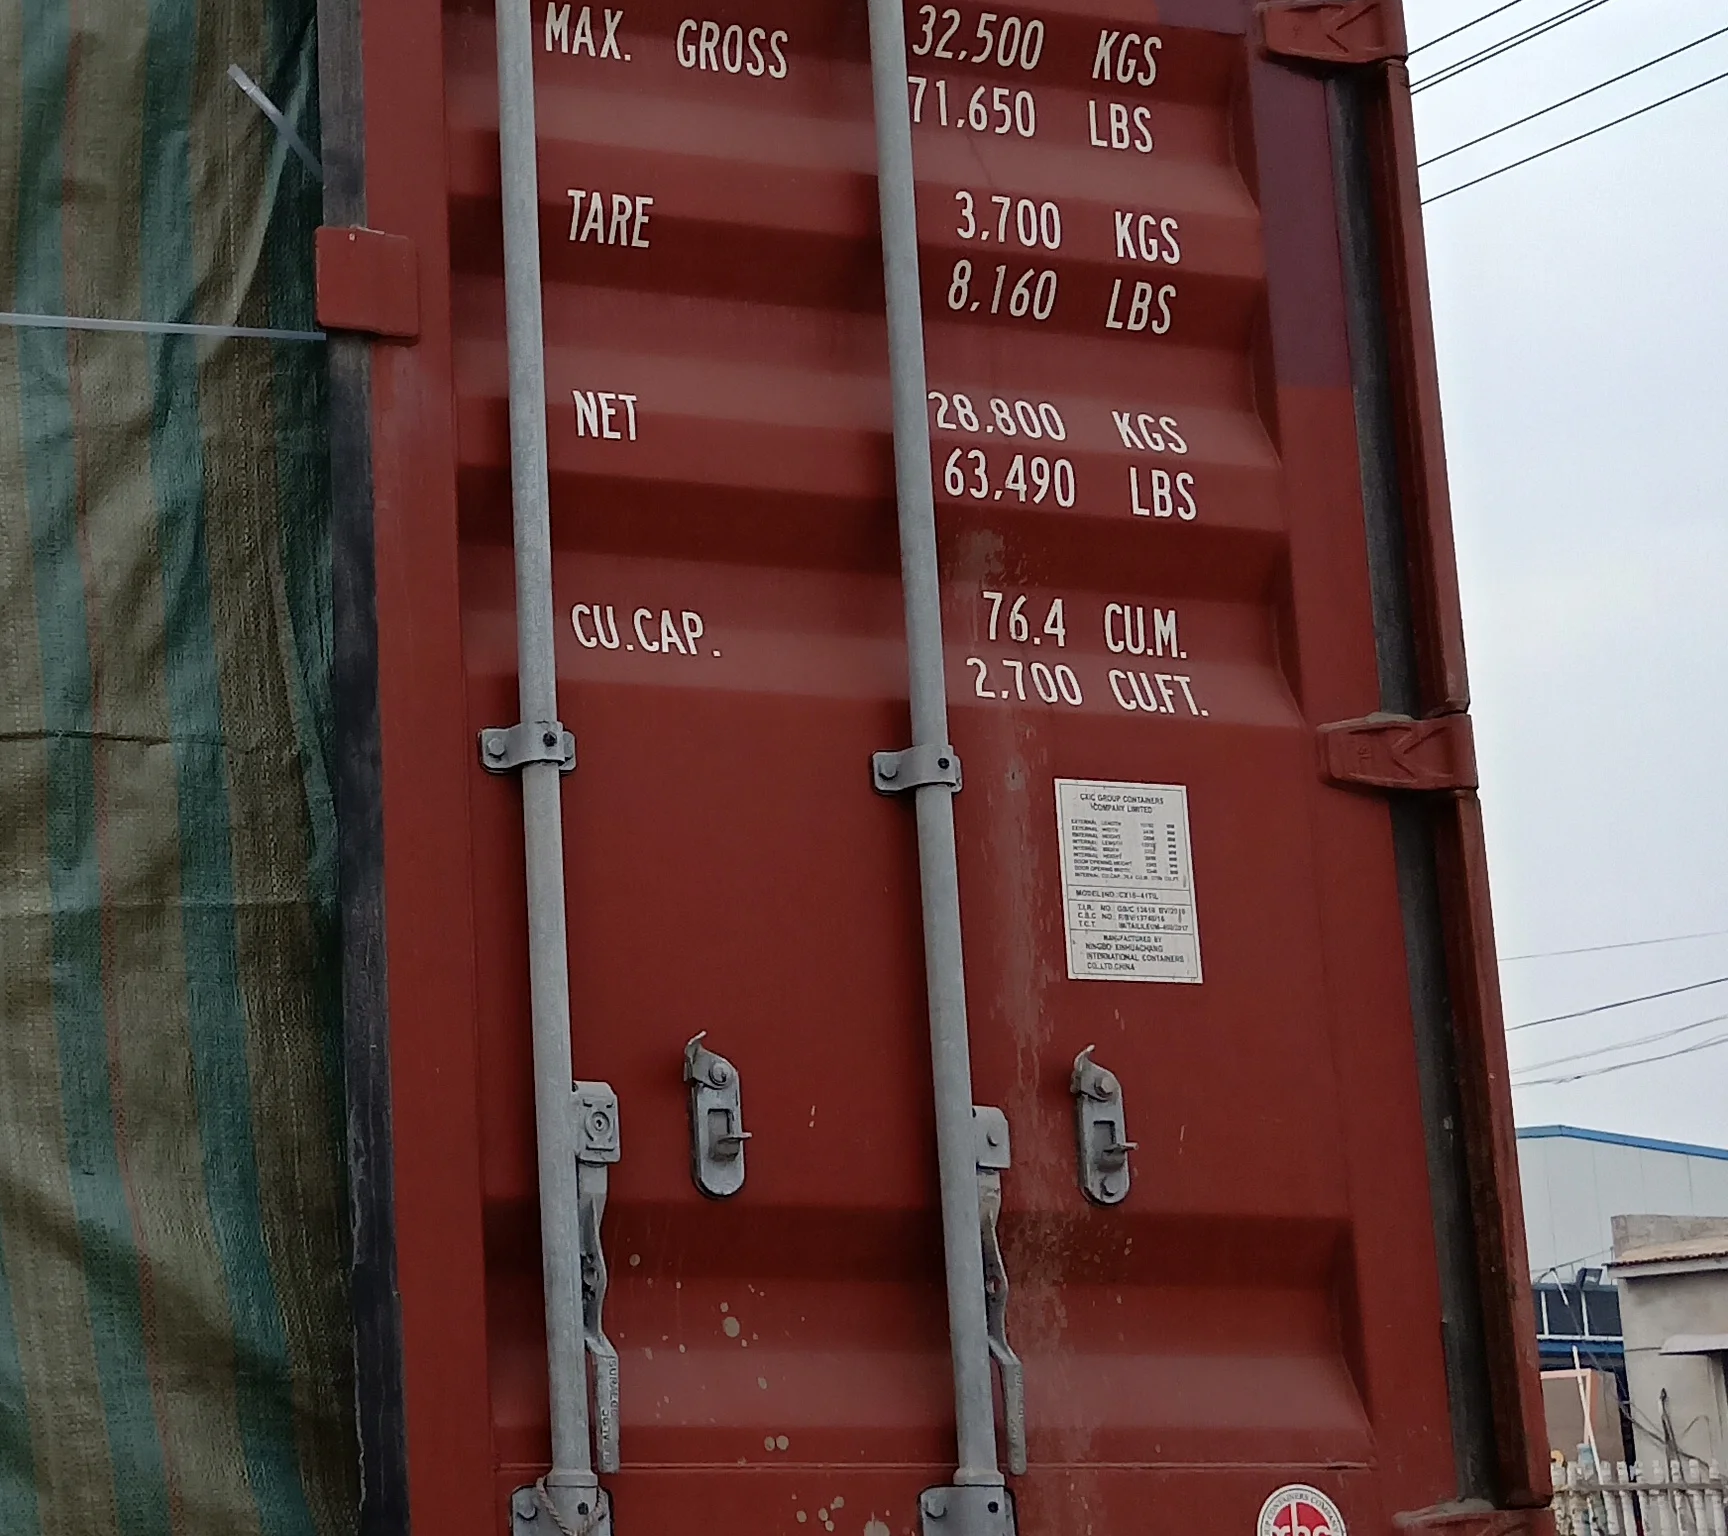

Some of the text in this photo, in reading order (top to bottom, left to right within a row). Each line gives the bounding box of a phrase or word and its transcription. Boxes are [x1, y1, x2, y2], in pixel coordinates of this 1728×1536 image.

[545, 2, 1162, 86] MAX. GROSS 32,500 KGS
[908, 76, 1154, 153] 71,650 LBS
[567, 189, 1181, 265] TARE 3,700 KGS
[948, 259, 1177, 335] 8,160 LBS
[572, 389, 637, 441] NET
[1111, 410, 1188, 454] KGS
[944, 448, 1197, 521] 63,490 LBS
[983, 591, 1066, 647] 76.4
[1104, 603, 1187, 659] CU.M.
[1108, 669, 1209, 717] CU.FT.
[1093, 804, 1153, 814] COMPANY LIMITED
[1098, 794, 1121, 803] GROUP
[1123, 795, 1164, 805] CONTAINERS
